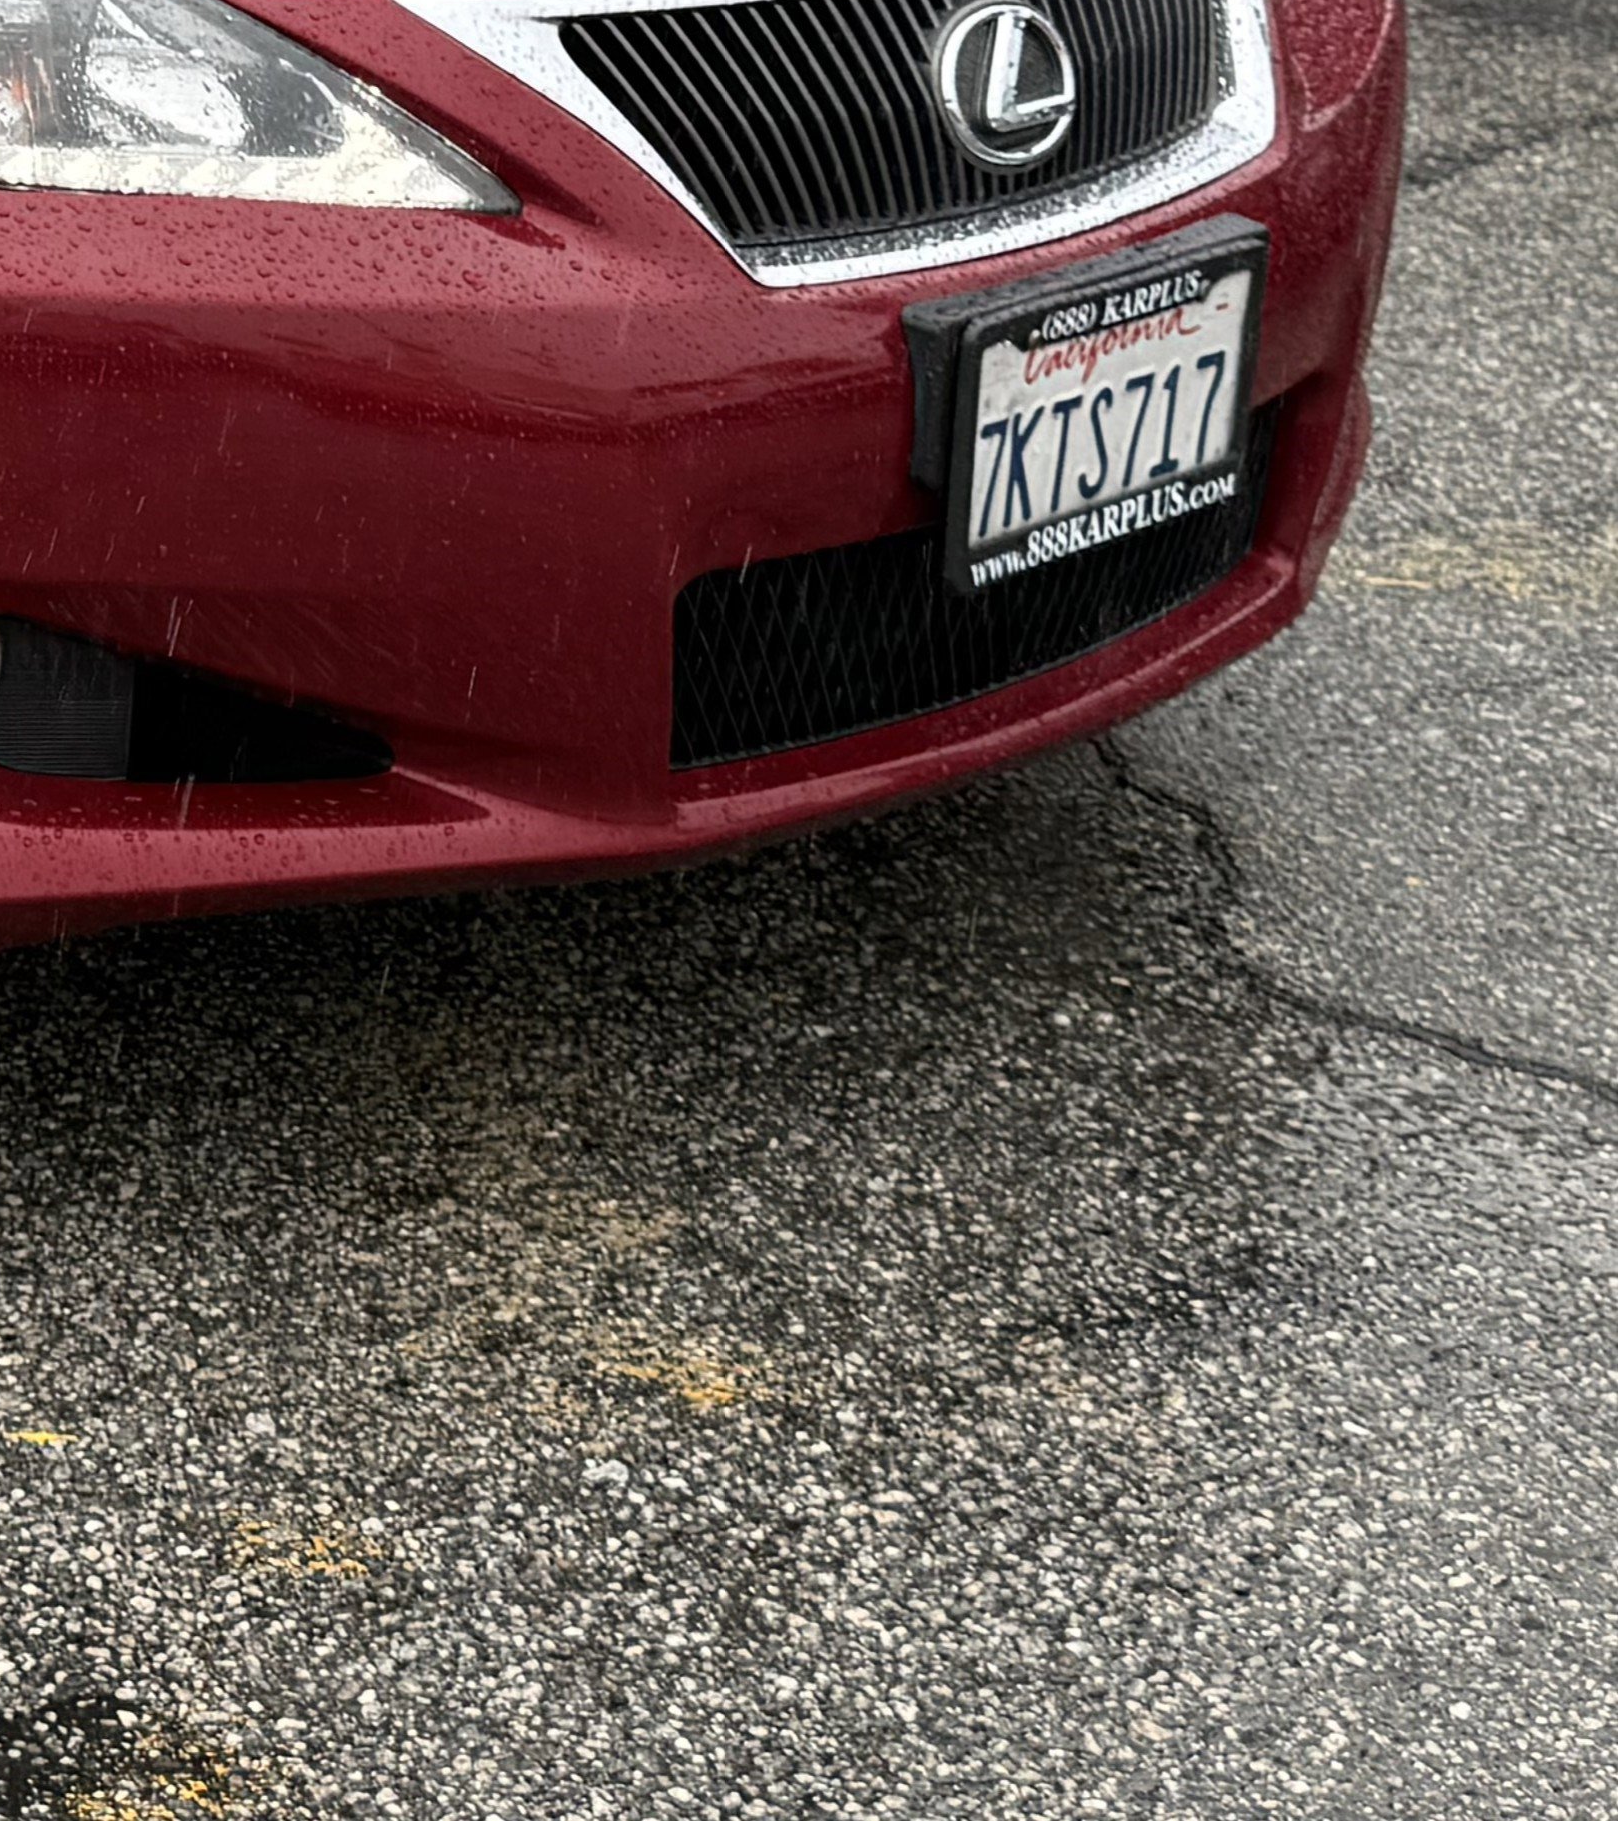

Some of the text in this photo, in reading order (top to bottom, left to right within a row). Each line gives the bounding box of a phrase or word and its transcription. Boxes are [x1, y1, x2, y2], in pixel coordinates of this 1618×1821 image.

[1042, 269, 1203, 341] (888) KARPLUS
[979, 350, 1226, 537] 7KTS717
